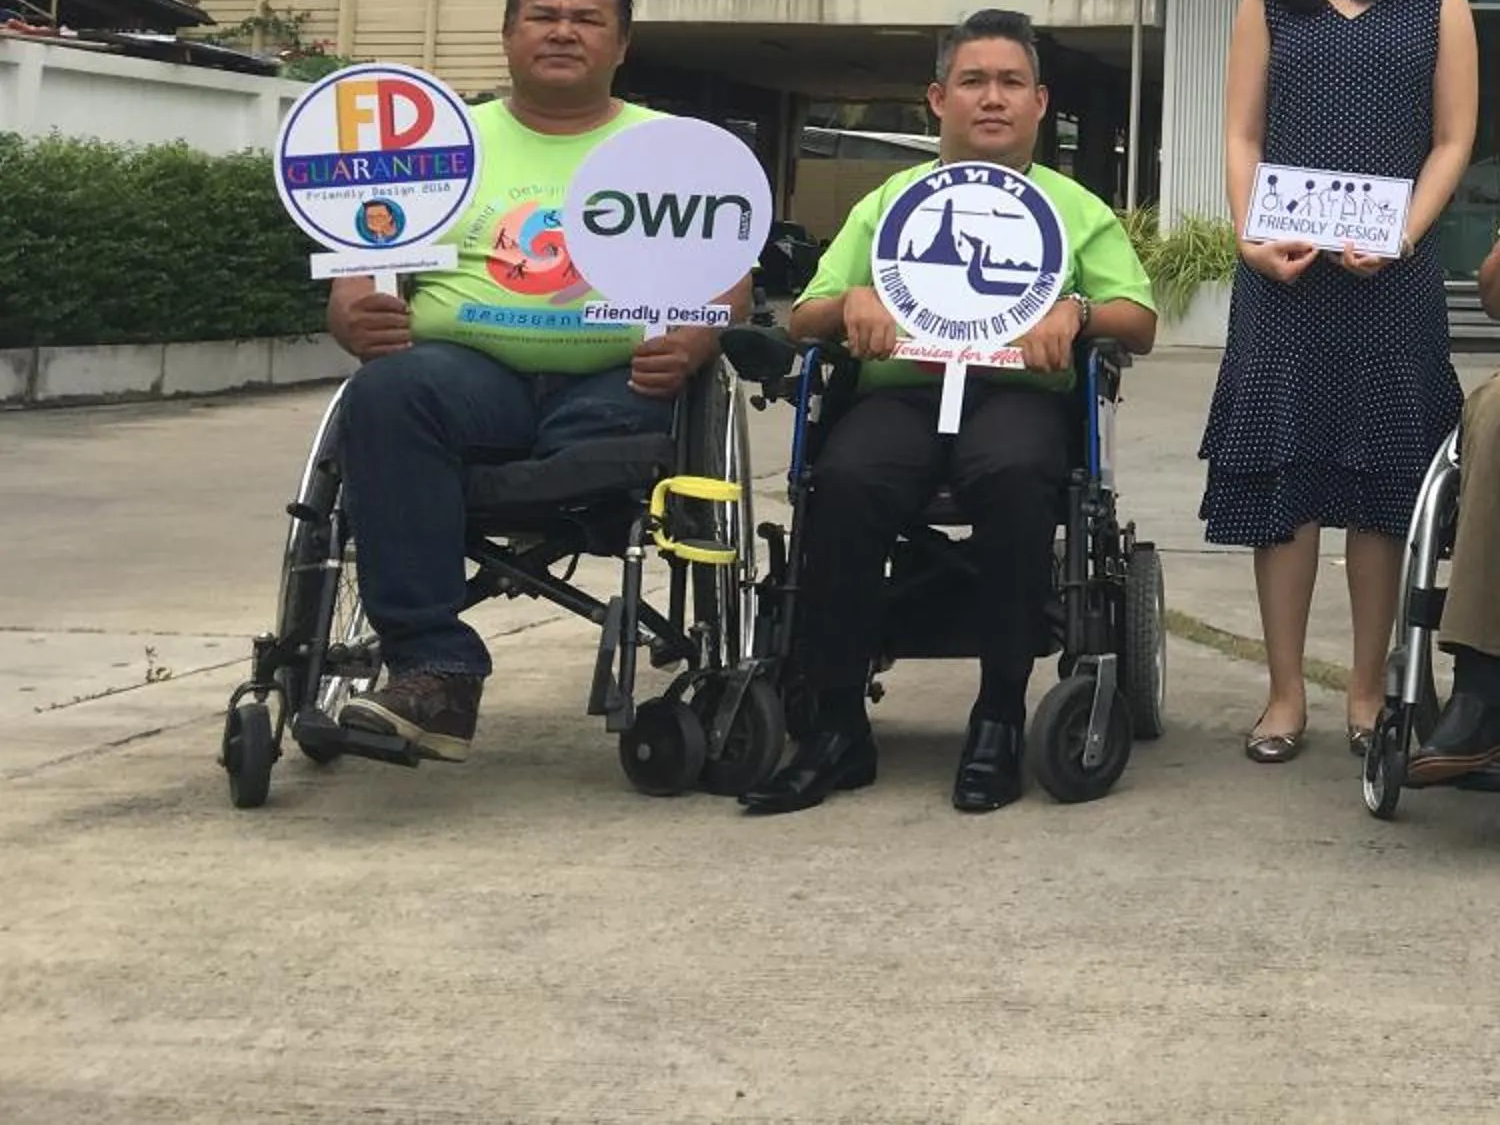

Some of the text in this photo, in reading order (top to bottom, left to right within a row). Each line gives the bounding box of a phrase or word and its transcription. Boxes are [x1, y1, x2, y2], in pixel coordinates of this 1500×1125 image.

[336, 78, 435, 154] FD
[287, 152, 468, 184] GUARANTEE
[306, 182, 451, 202] Friendly Design 2018
[1257, 214, 1390, 242] FRIENDLY DESIGN
[584, 305, 729, 327] Friendly Design
[879, 264, 1057, 340] TOURISM AUTHORITY OF THAILAND
